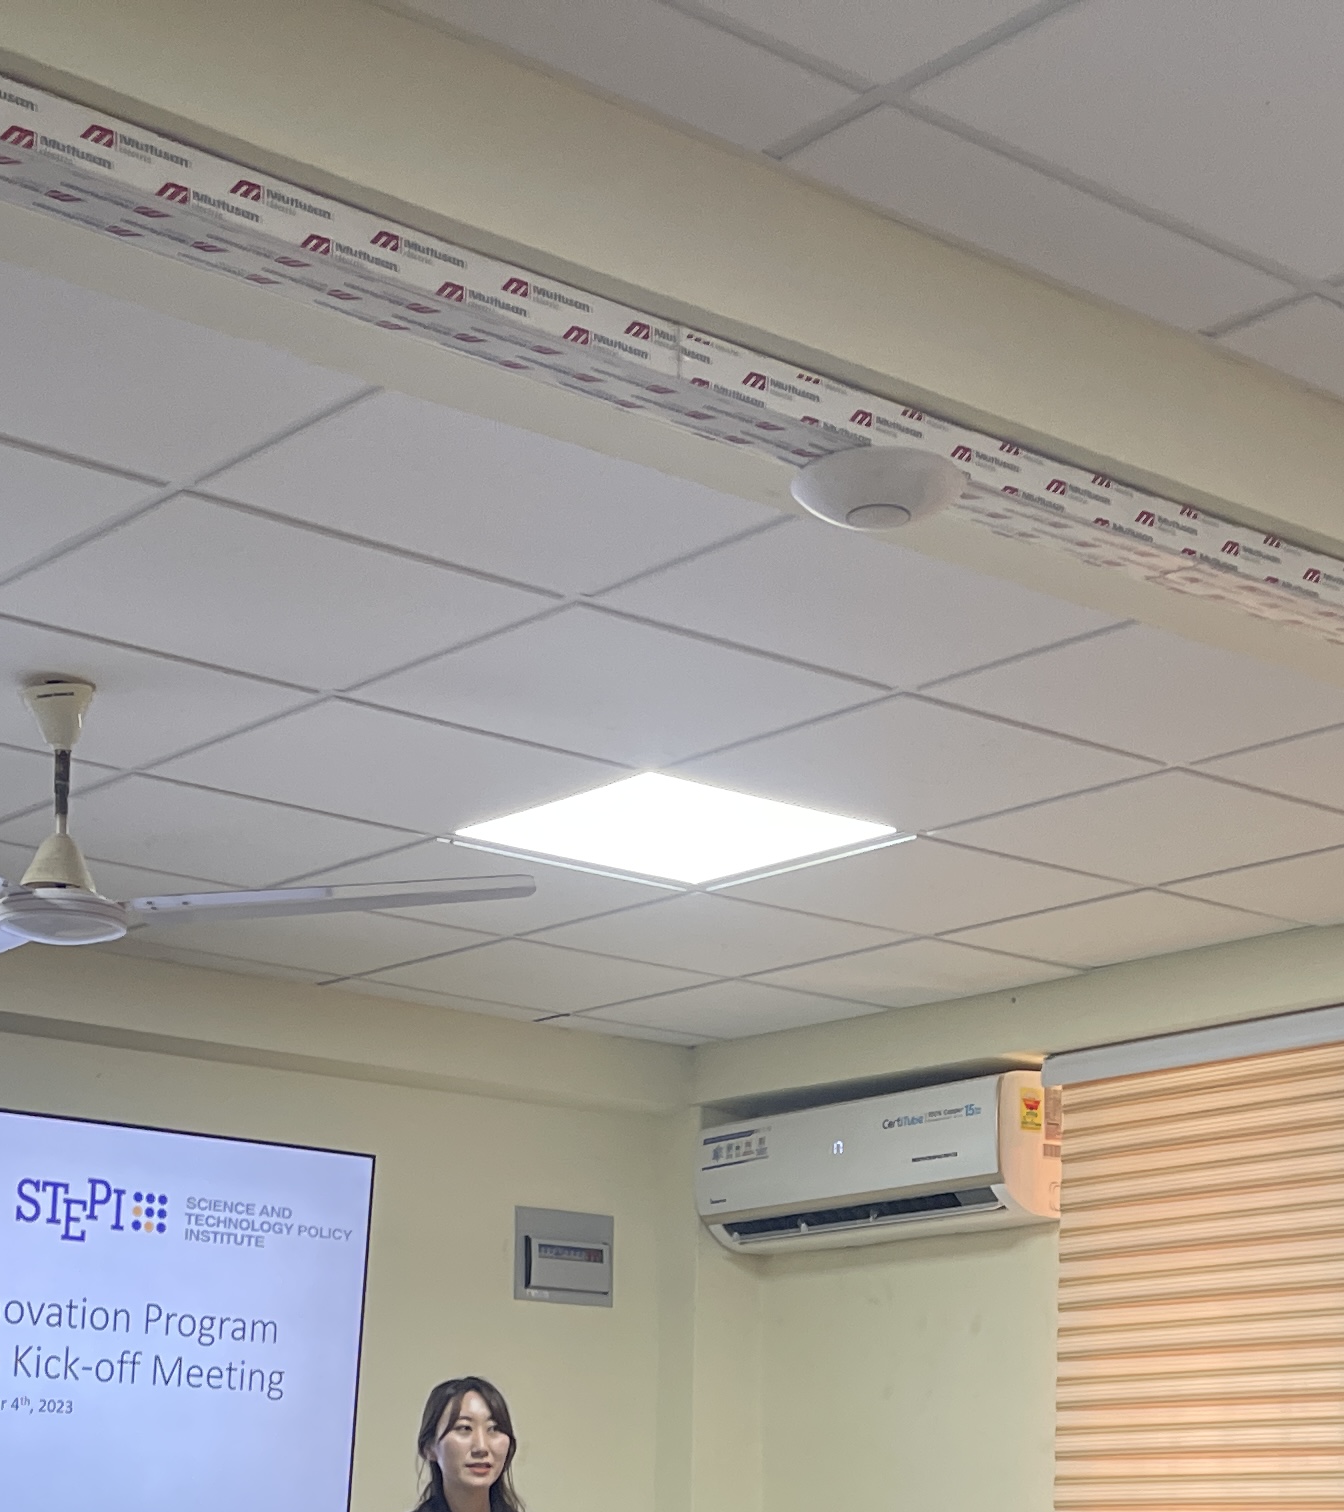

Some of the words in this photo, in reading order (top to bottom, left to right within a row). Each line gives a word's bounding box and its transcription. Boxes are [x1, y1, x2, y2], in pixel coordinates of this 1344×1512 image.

[15, 1177, 126, 1243] STEPI
[185, 1196, 256, 1217] SCIENCE
[259, 1205, 293, 1220] AND
[184, 1212, 294, 1236] TECHNOLOGY
[297, 1225, 353, 1243] POLICY
[184, 1228, 265, 1249] INSTITUTE
[144, 1302, 279, 1348] Program
[12, 1344, 142, 1386] Kick-off
[151, 1355, 286, 1401] Meeting
[9, 1395, 35, 1417] 4th,
[38, 1397, 74, 1416] 2023
